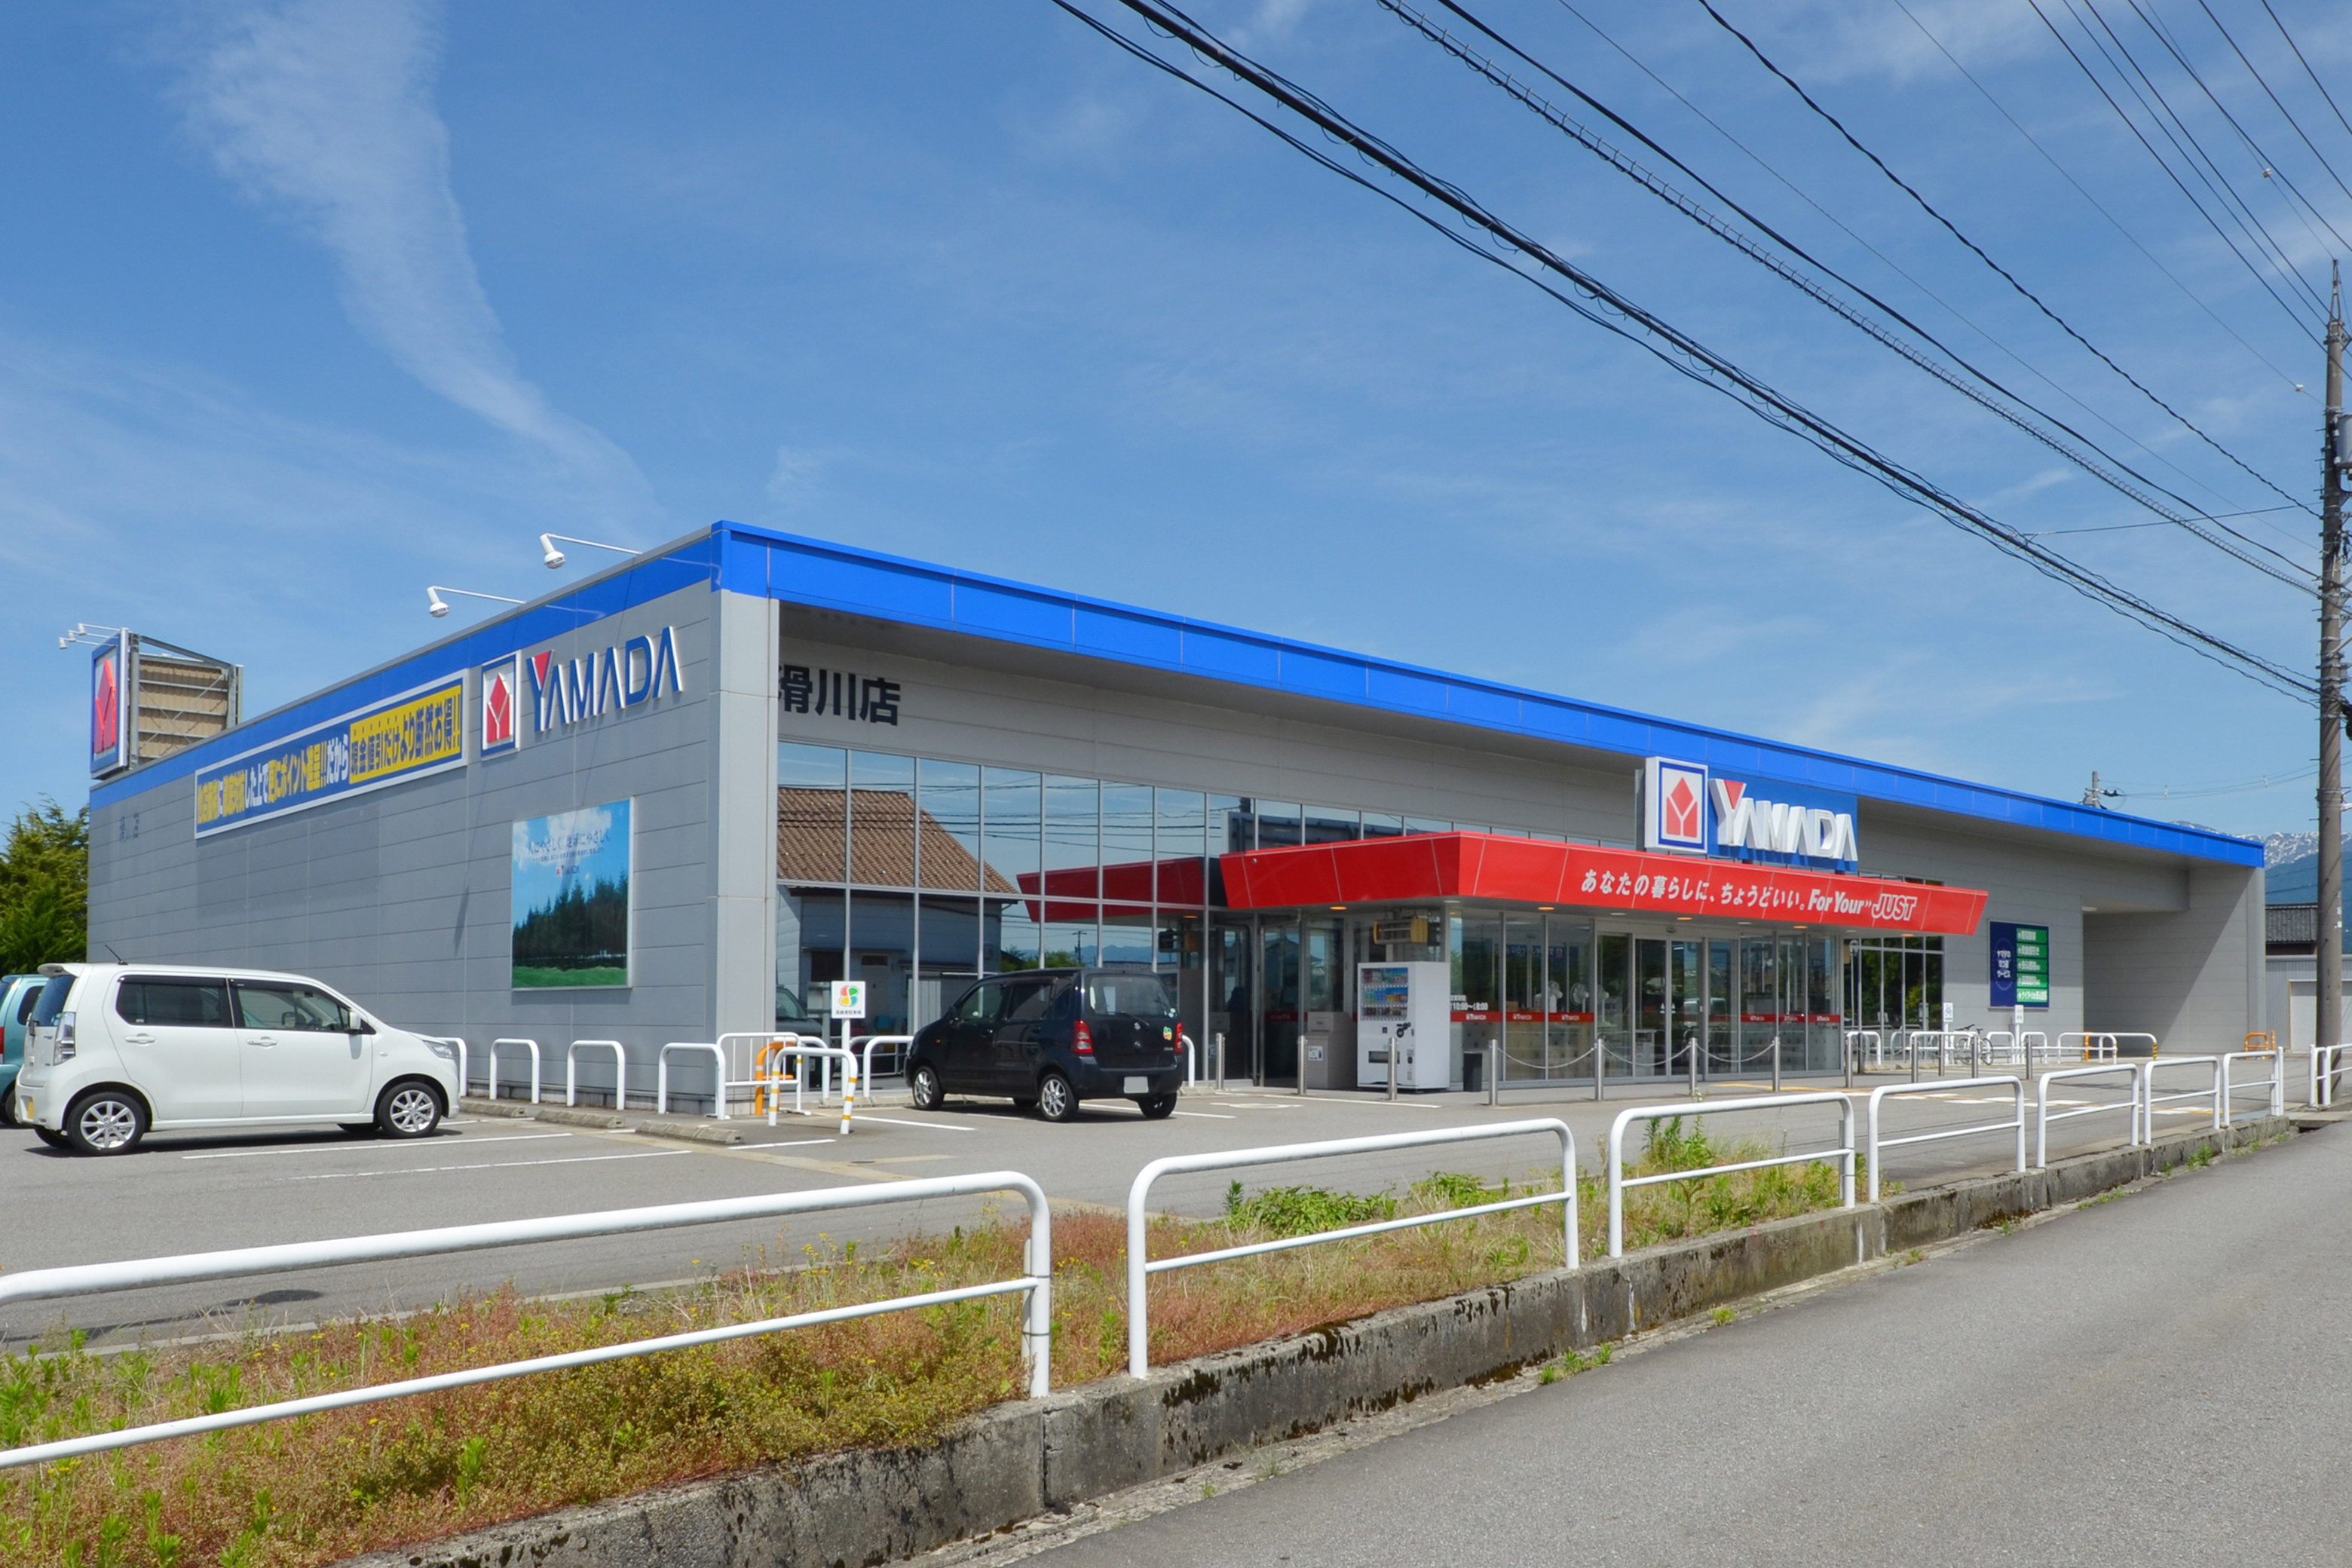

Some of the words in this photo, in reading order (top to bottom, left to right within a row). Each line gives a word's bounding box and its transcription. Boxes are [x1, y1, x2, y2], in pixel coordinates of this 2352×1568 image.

[526, 626, 683, 733] YAMADA
[779, 664, 900, 726] 滑川店
[1708, 779, 1858, 862] YAMADA
[1581, 868, 1805, 911] あなたの暮らしに、ちょうどいい。
[1808, 888, 1833, 911] For
[1871, 893, 1919, 921] JUST
